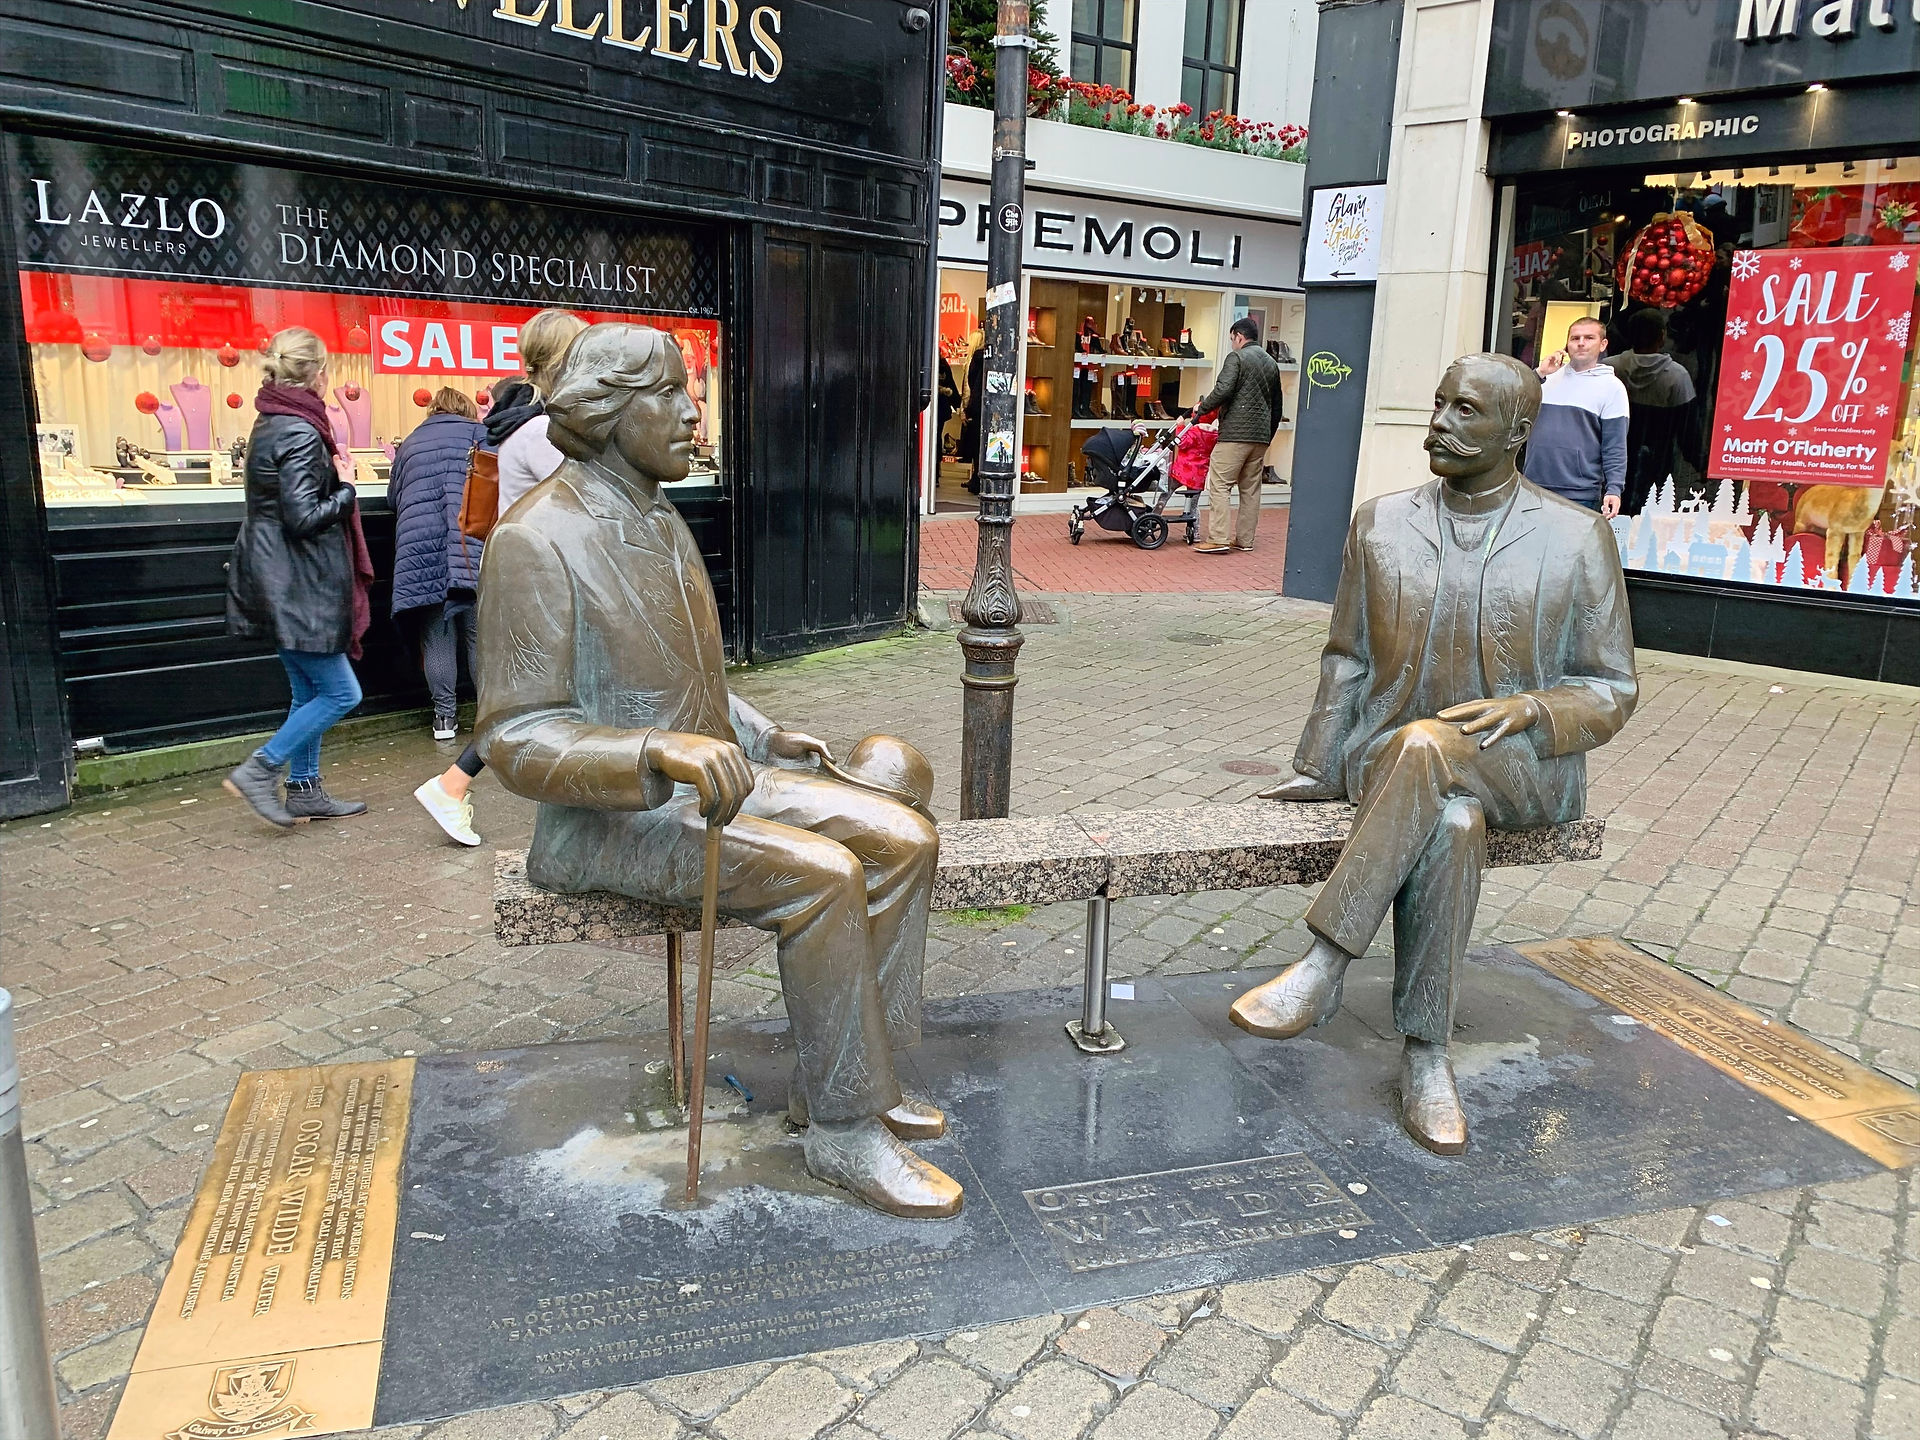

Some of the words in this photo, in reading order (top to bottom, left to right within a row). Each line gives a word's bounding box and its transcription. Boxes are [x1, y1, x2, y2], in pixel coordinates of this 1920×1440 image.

[1736, 0, 1920, 40] Mat
[455, 0, 783, 83] LLERS
[1567, 115, 1759, 149] PHOTOGRAPHIC
[31, 178, 226, 239] LAZLO
[276, 204, 330, 230] THE
[1328, 192, 1367, 222] Glam
[80, 234, 187, 255] JEWELLERS
[1328, 216, 1367, 248] Gals
[278, 232, 477, 280] DIAMOND
[491, 252, 657, 294] SPECIALIST
[700, 306, 714, 315] 1967
[940, 296, 966, 313] SALE
[1756, 270, 1880, 326] SALE
[381, 320, 521, 370] SALE
[1831, 404, 1865, 423] OFF
[1722, 454, 1766, 465] Chemists
[1723, 438, 1769, 453] Matt
[1773, 440, 1877, 463] O'Flaherty
[1783, 460, 1807, 468] Health,
[1820, 462, 1845, 470] Beauty,
[1678, 1010, 1778, 1061] EDUARD
[1774, 1061, 1845, 1099] ESTONIAN
[284, 1118, 324, 1183] OSCAR
[348, 1152, 360, 1164] OF
[361, 1152, 374, 1173] WITH
[329, 1165, 342, 1180] LIFE
[359, 1174, 371, 1189] THE
[324, 1181, 339, 1203] THAT
[339, 1171, 357, 1209] COUNTRY
[356, 1190, 368, 1207] ART
[265, 1185, 308, 1255] WILDE
[322, 1203, 335, 1217] WE
[334, 1210, 350, 1235] GAINS
[354, 1208, 365, 1219] OF
[1043, 1182, 1343, 1246] WILDE
[317, 1217, 332, 1239] CALL
[347, 1220, 364, 1257] FOREIGN
[218, 1229, 236, 1254] SELLE
[329, 1236, 345, 1260] THAT
[220, 1254, 246, 1302] KUNSTIGA
[252, 1263, 281, 1318] WRITER
[339, 1258, 357, 1300] NATIONS
[189, 1424, 226, 1437] Galway
[227, 1423, 250, 1434] City
[252, 1411, 294, 1429] Council
